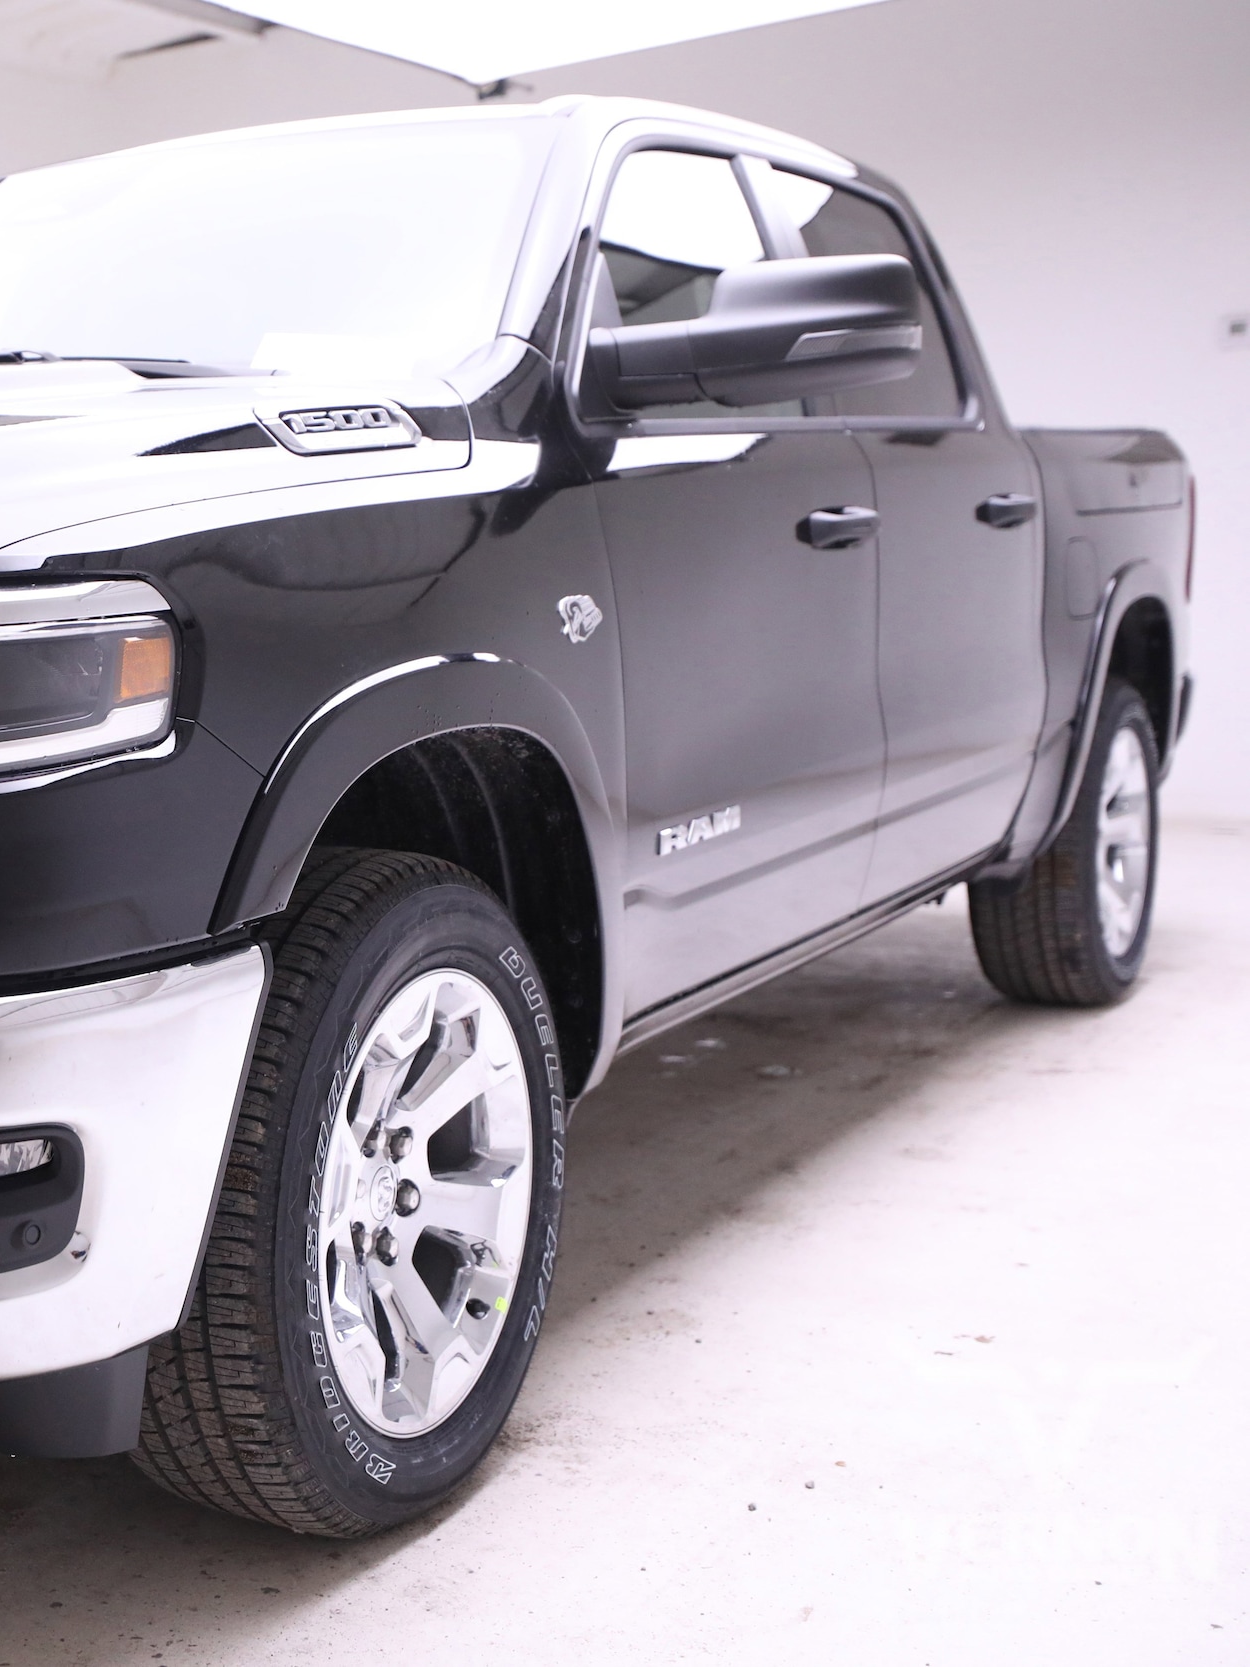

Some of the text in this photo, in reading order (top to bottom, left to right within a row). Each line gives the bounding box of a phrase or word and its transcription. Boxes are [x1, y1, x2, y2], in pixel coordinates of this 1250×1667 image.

[281, 407, 393, 434] 1500
[657, 804, 741, 857] RAM
[499, 946, 566, 1191] DUELER
[305, 1022, 397, 1485] BRIDGESTONE
